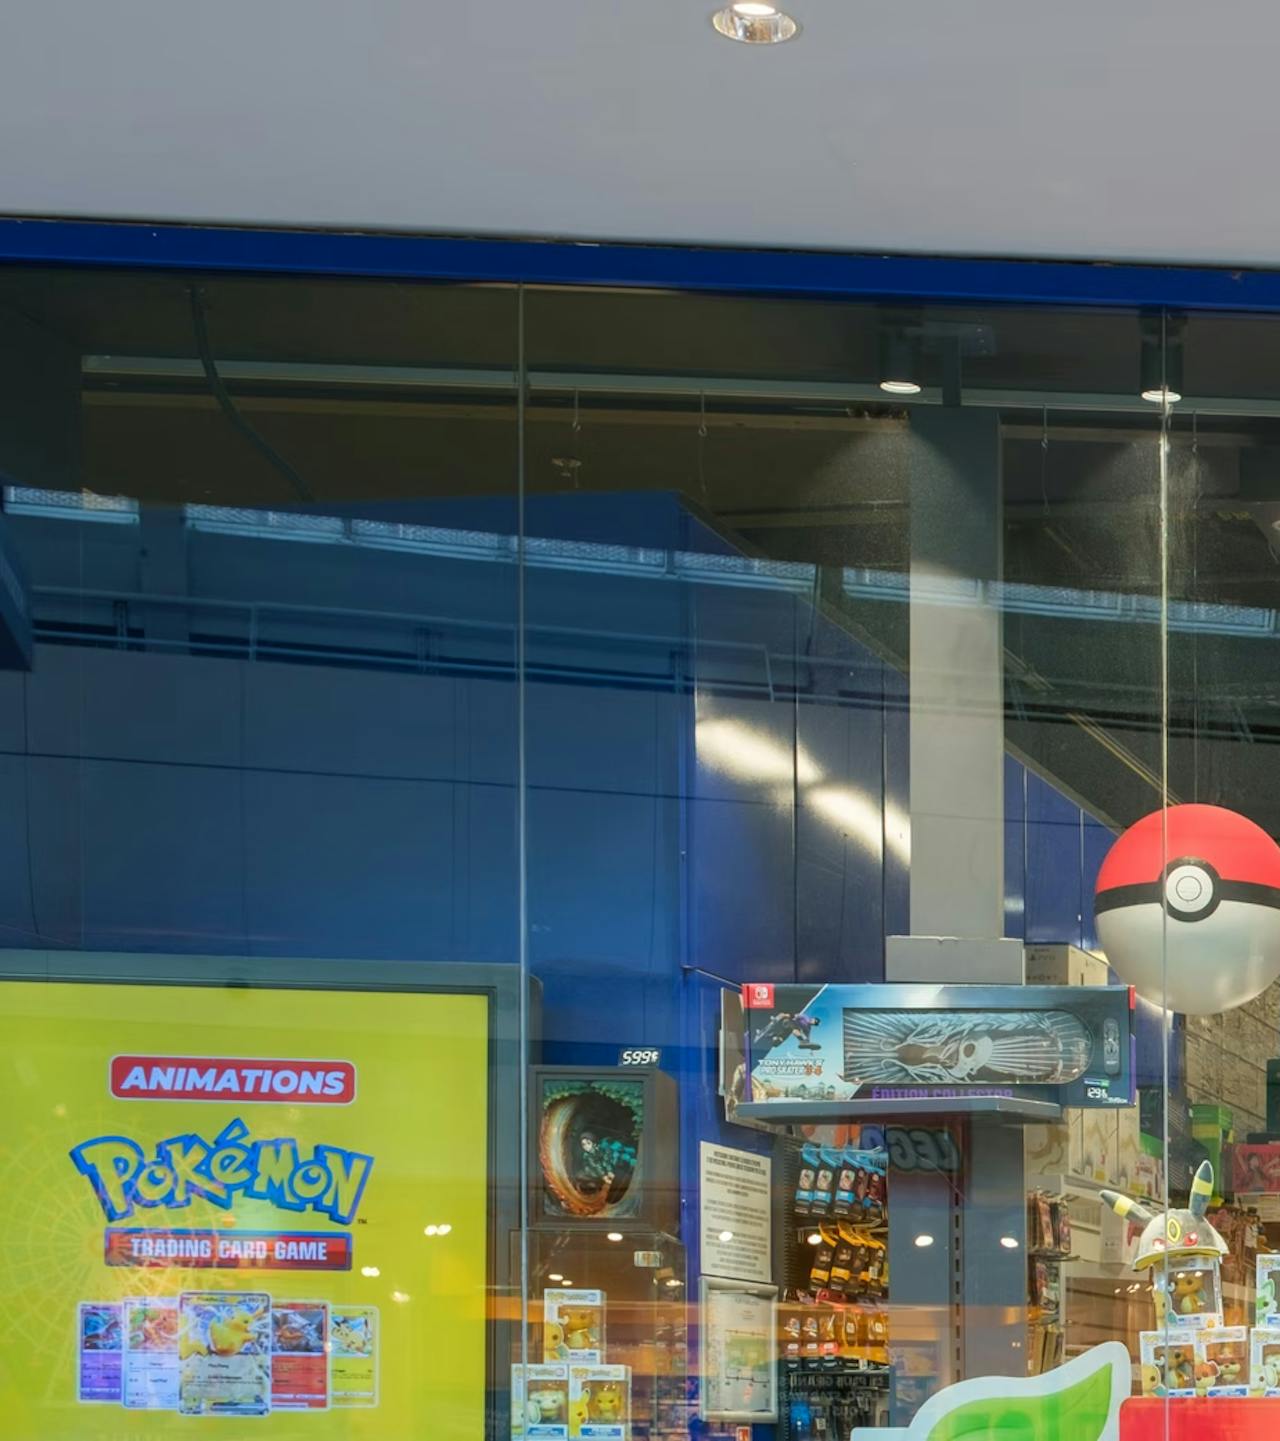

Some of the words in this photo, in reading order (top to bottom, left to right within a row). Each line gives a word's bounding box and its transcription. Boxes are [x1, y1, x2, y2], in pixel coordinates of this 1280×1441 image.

[120, 1066, 346, 1095] ANIMATIONS
[130, 1238, 211, 1259] TRADING
[218, 1239, 268, 1260] CARD
[274, 1241, 328, 1260] GAME
